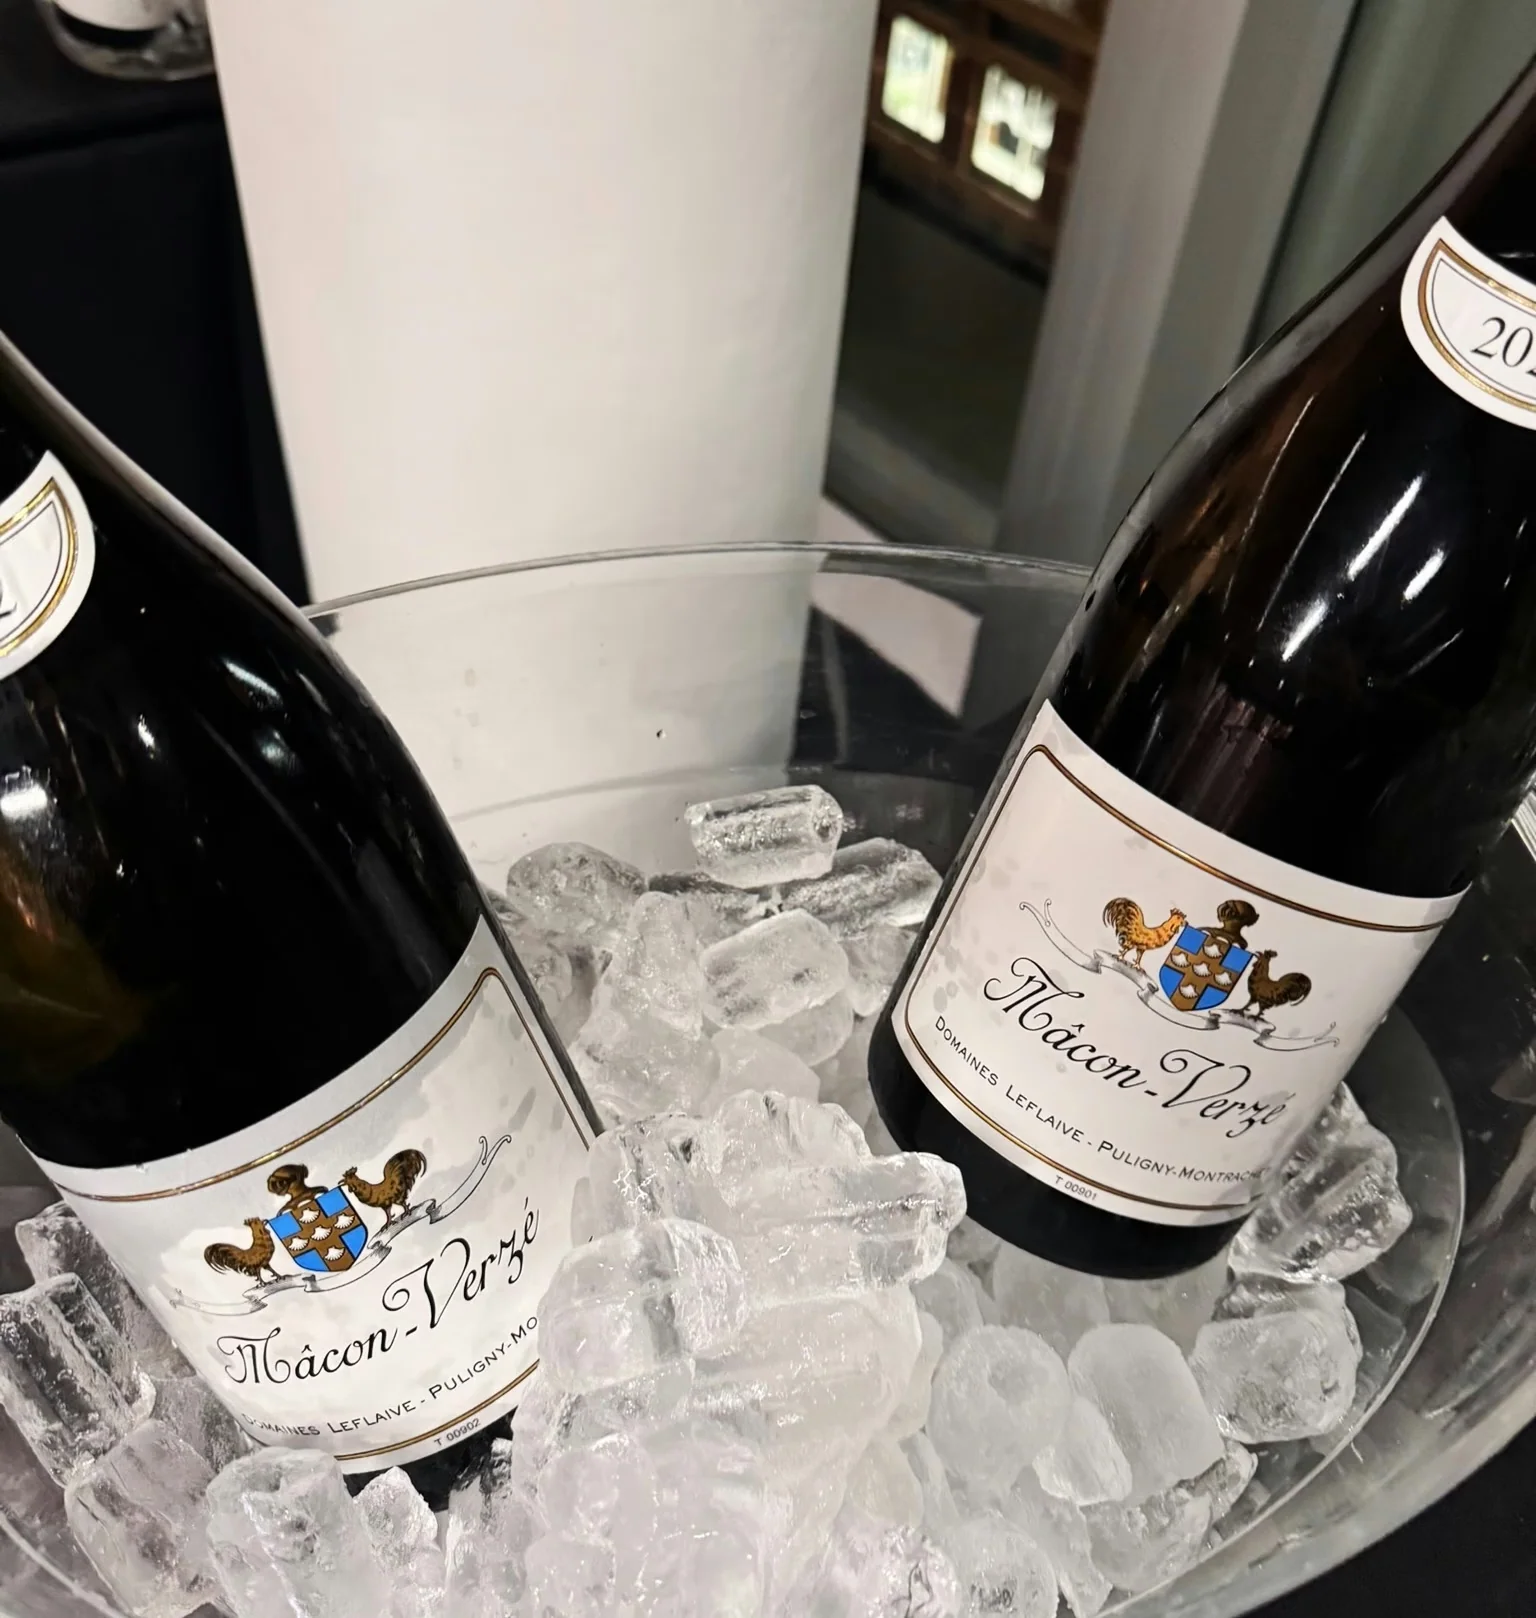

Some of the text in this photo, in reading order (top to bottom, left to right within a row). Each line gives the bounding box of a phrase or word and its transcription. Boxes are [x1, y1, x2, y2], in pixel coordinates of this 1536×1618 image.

[935, 1015, 999, 1086] DOMAINES
[1005, 1084, 1085, 1144] LEFLAIVE
[983, 957, 1297, 1138] Mâcon-Verzé
[1055, 1175, 1098, 1201] T 00901
[216, 1197, 539, 1384] Mâcon-Verzé
[327, 1400, 417, 1434] LEFLAIVE
[428, 1316, 538, 1400] PULIGNY-MO
[434, 1417, 482, 1447] T 00902
